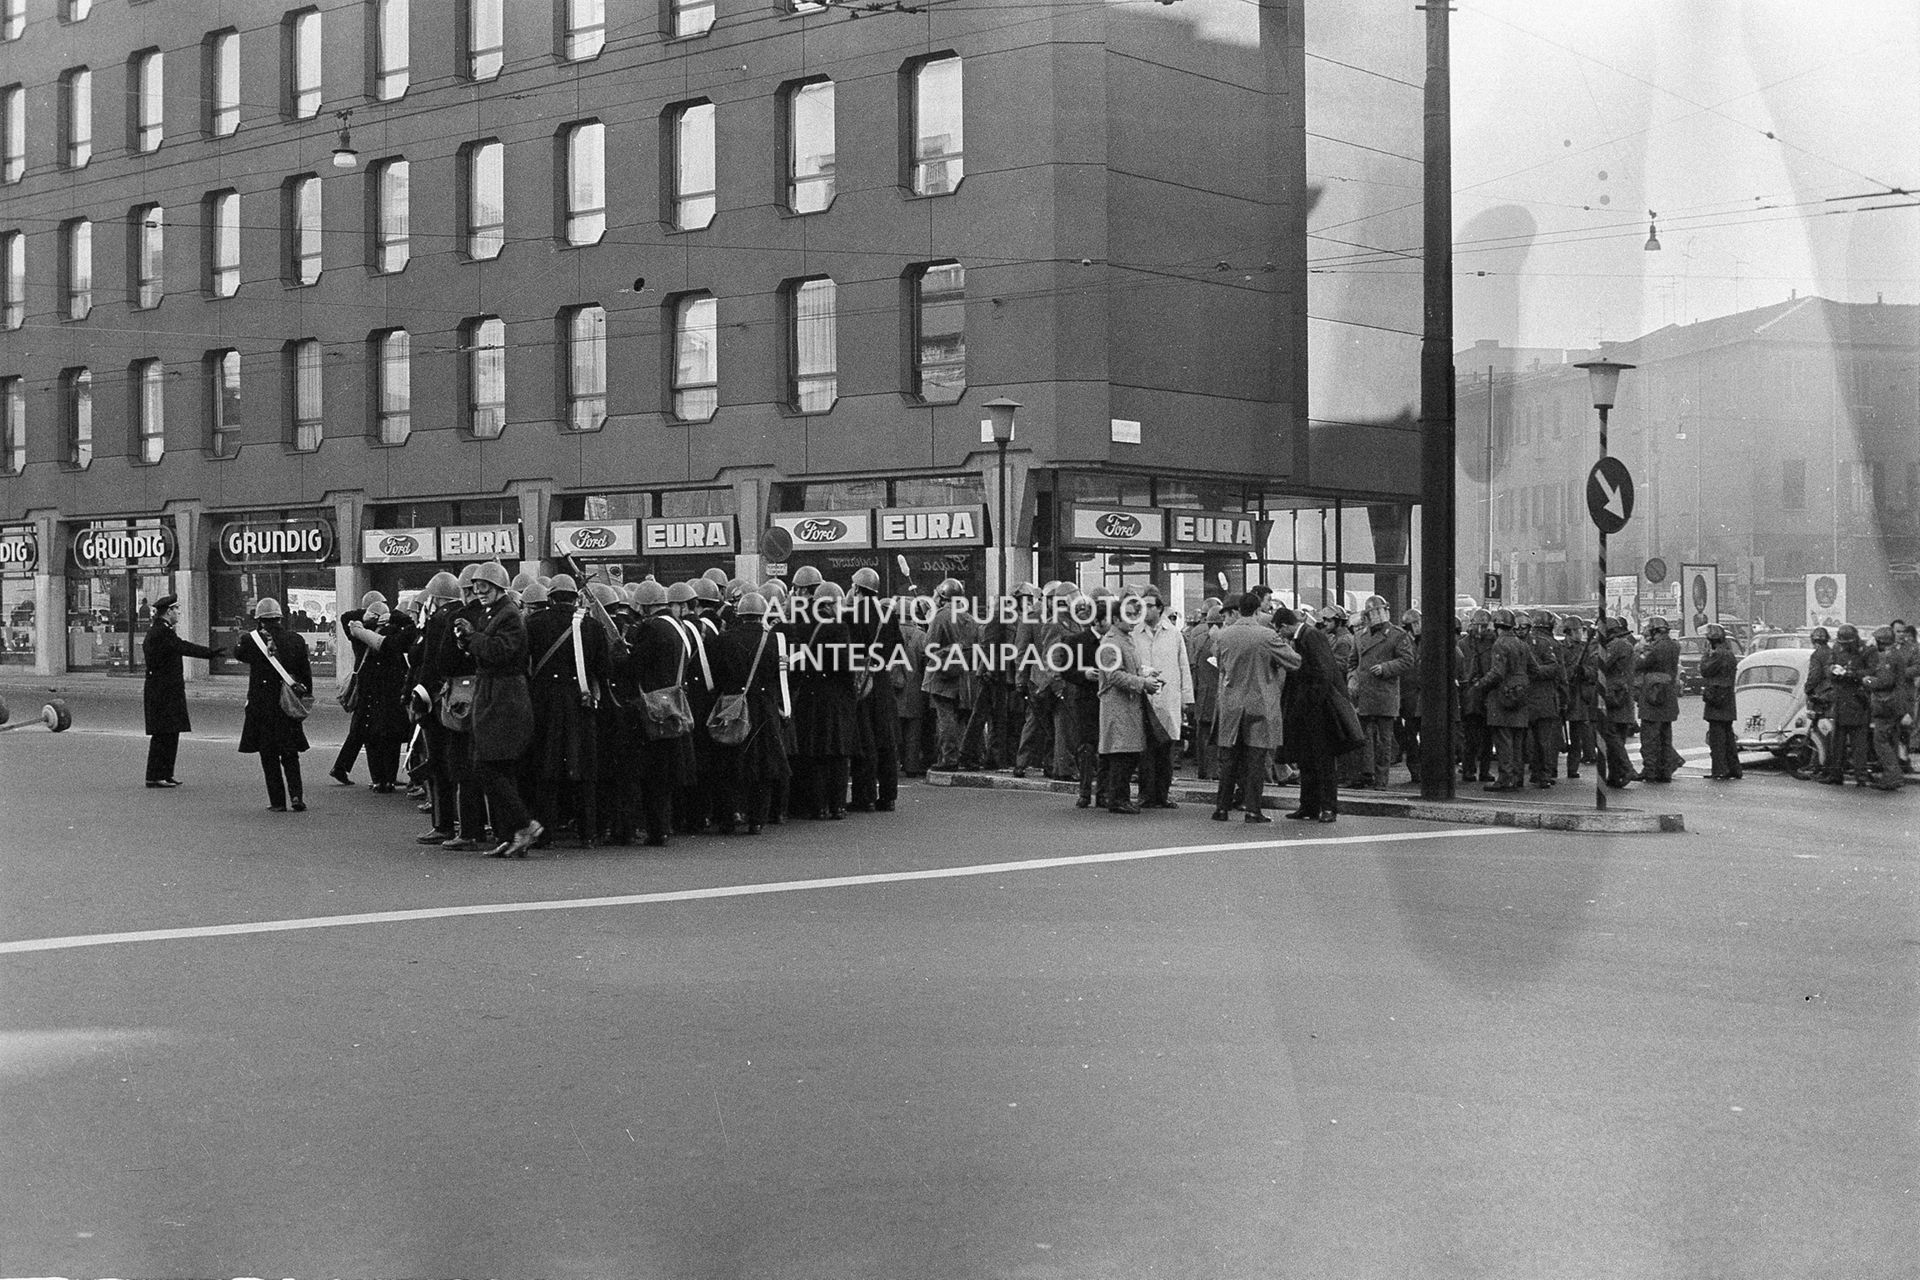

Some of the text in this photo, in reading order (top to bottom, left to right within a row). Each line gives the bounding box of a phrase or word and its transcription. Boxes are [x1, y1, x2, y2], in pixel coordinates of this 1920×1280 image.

[647, 522, 727, 548] EURA
[800, 519, 837, 541] Ford
[883, 512, 975, 541] EURA
[1104, 514, 1136, 537] Ford
[1176, 516, 1253, 545] EURA
[83, 535, 165, 559] GRUNDIG
[229, 529, 322, 554] GRUNDIG
[384, 535, 411, 556] Ford
[445, 530, 514, 555] EURA
[576, 528, 607, 548] Ford
[1489, 575, 1498, 598] P
